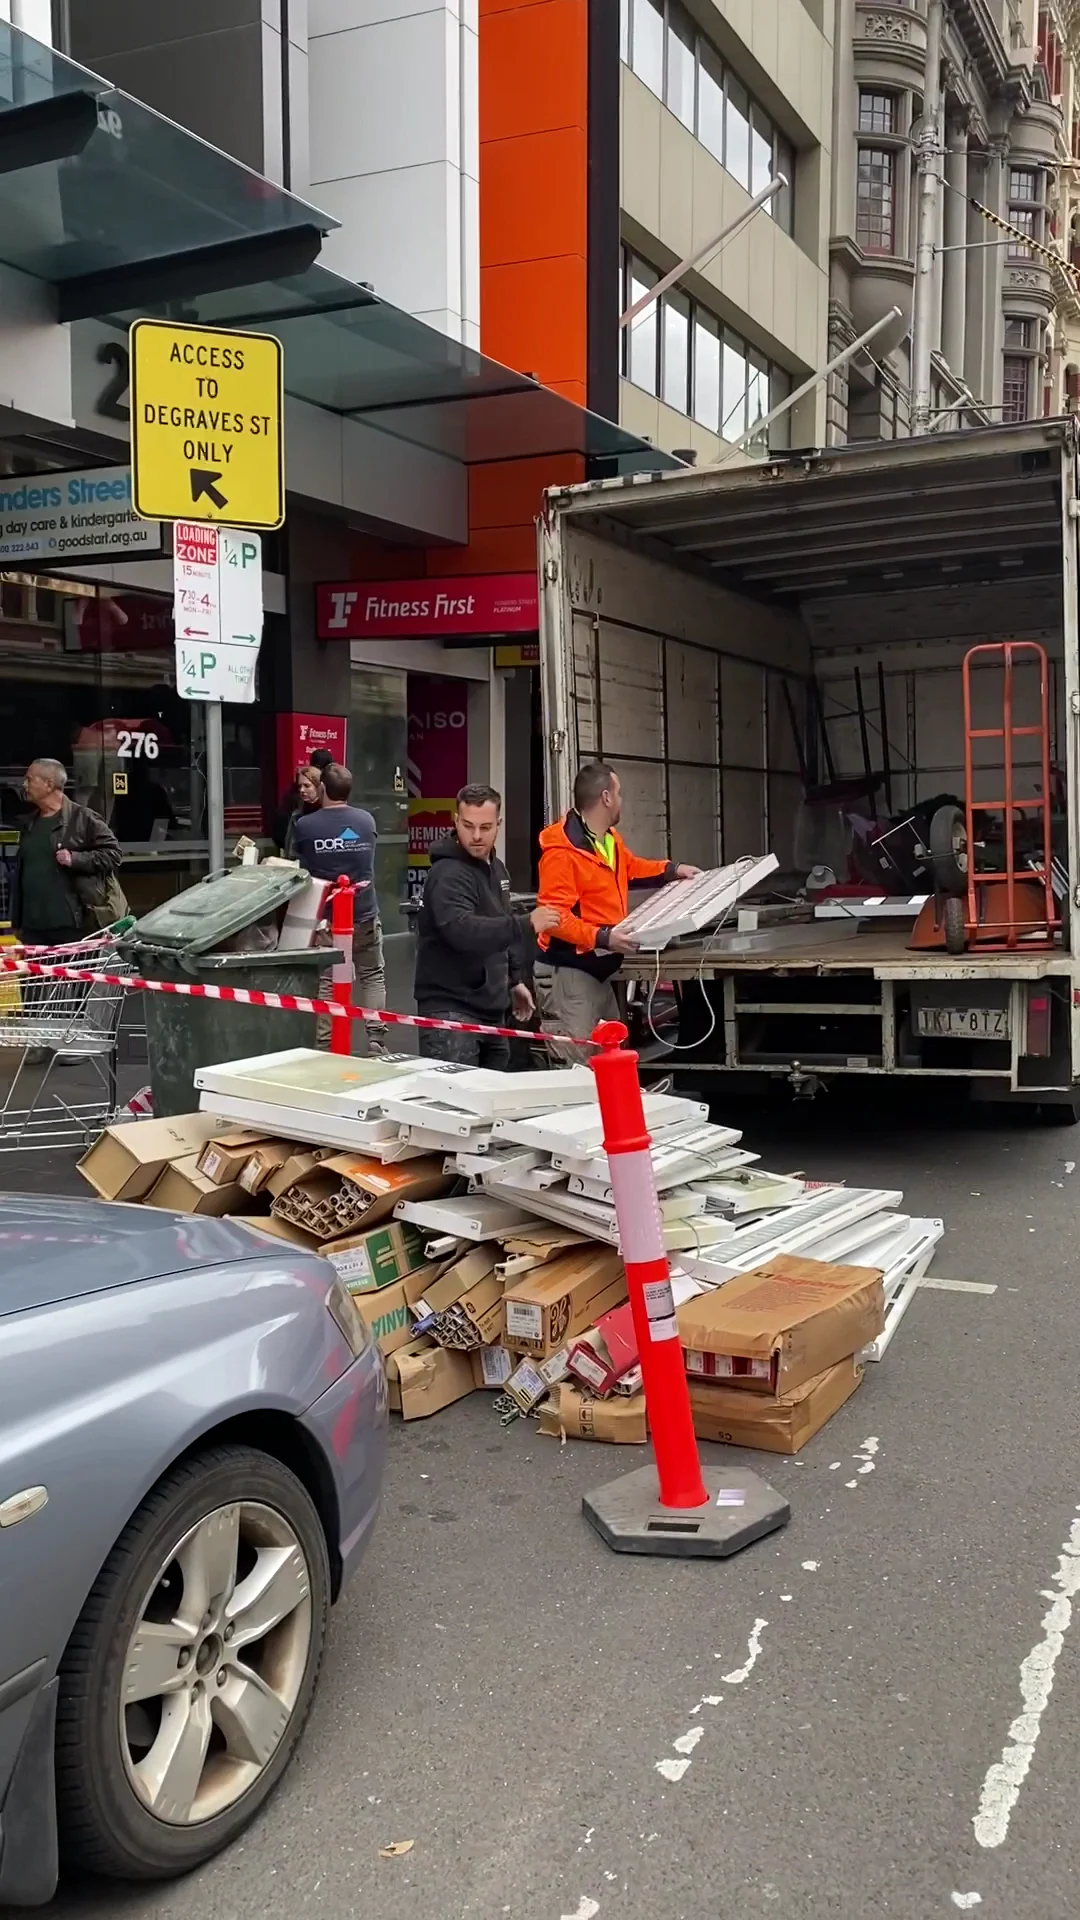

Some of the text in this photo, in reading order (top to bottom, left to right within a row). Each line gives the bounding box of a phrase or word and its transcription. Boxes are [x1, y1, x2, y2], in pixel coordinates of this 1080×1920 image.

[170, 342, 244, 370] ACCESS
[196, 377, 218, 398] TO
[144, 404, 271, 435] DEGRAVES ST
[183, 440, 233, 463] ONLY
[6, 509, 146, 535] day care & kindergarte
[58, 530, 147, 551] goodstart.org.au
[177, 525, 215, 546] LOADING
[177, 543, 216, 564] ZONE
[182, 565, 192, 576] 15
[116, 731, 159, 759] 276
[314, 838, 345, 851] DOR
